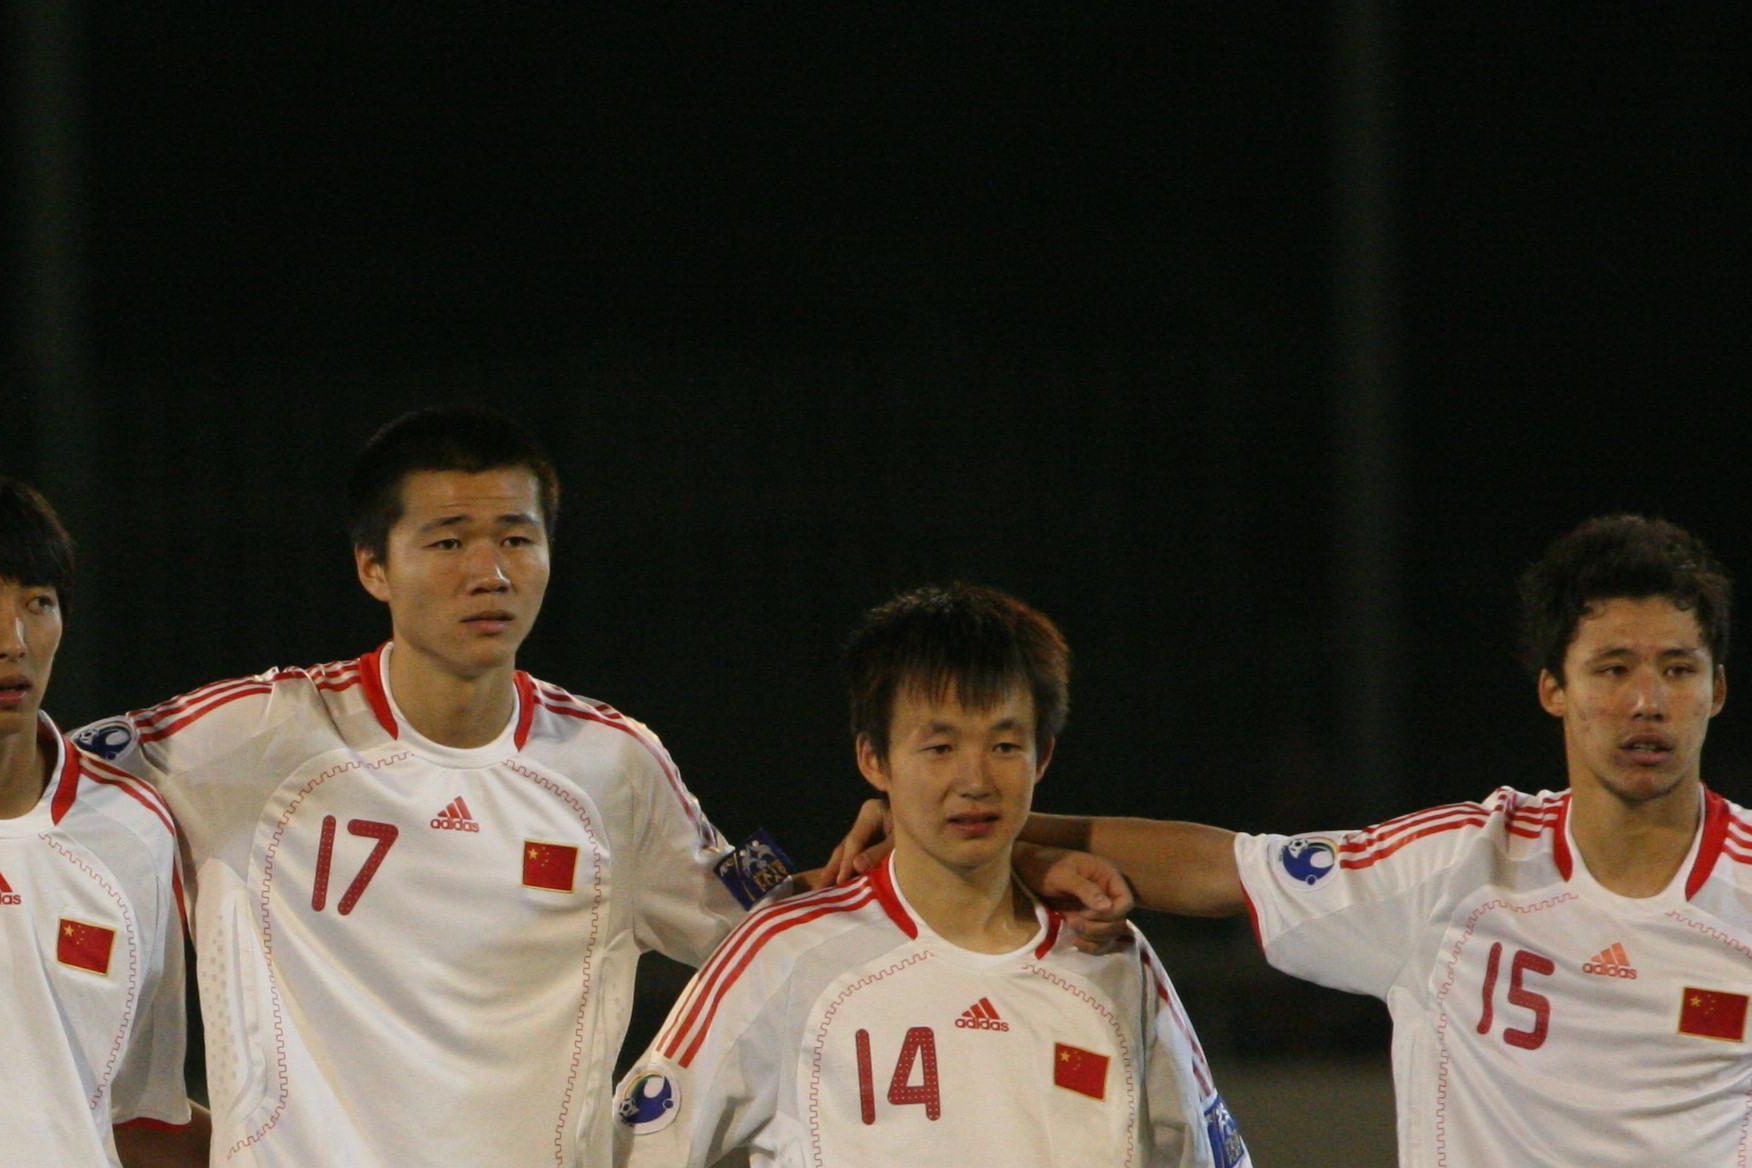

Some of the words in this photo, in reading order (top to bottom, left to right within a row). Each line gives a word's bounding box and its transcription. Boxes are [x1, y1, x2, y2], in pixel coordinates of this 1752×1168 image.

[430, 816, 480, 833] adidas
[310, 814, 400, 917] 17
[1475, 941, 1555, 1051] 15
[1581, 960, 1637, 980] adidas
[954, 1016, 1009, 1033] adidas
[854, 1025, 942, 1126] 14
